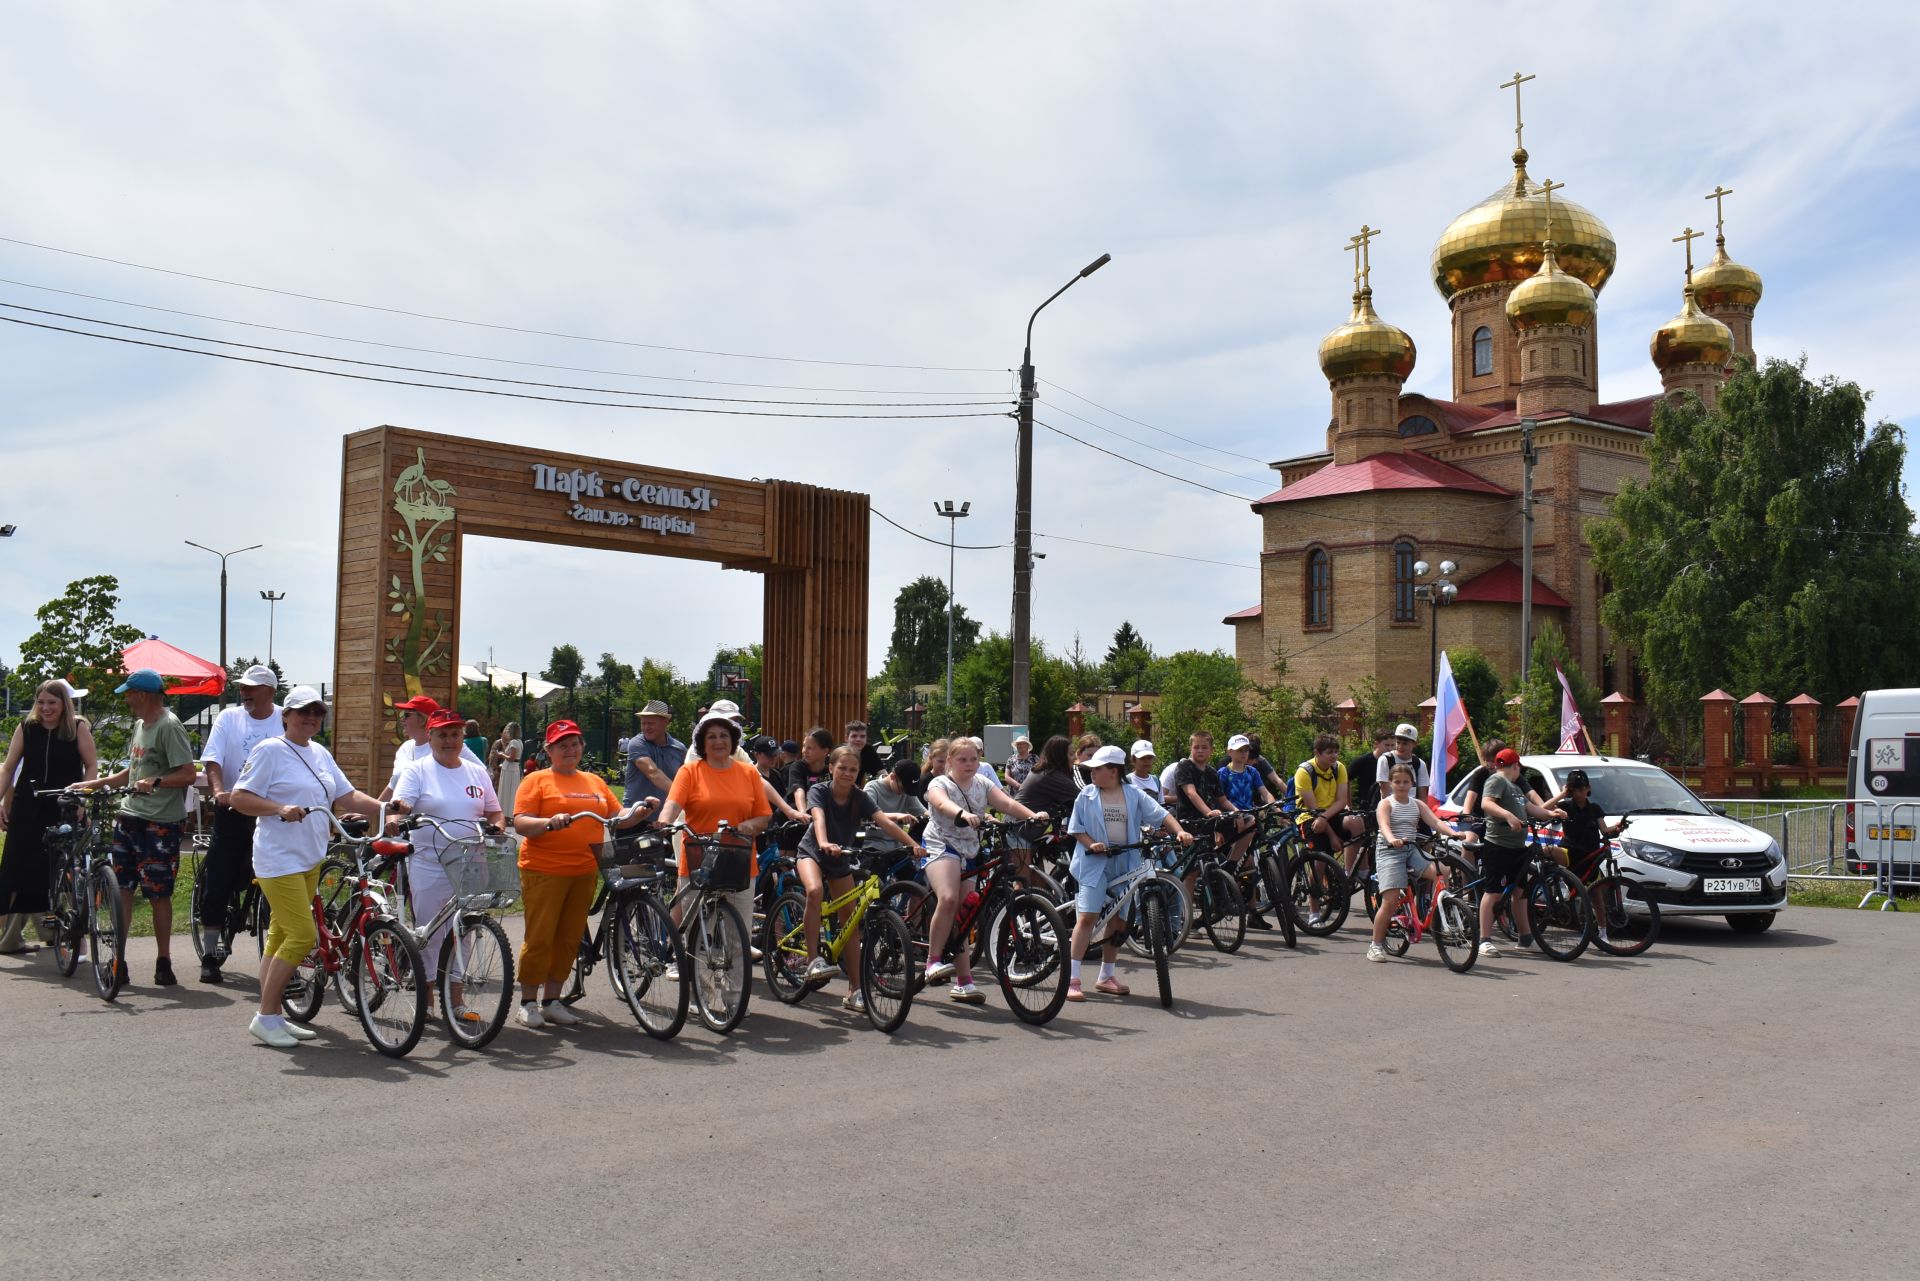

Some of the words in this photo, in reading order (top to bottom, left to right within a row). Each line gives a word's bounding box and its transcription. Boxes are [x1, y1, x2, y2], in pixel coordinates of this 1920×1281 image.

[531, 463, 605, 501] Парк
[639, 514, 696, 536] паркы
[1874, 779, 1886, 787] 60
